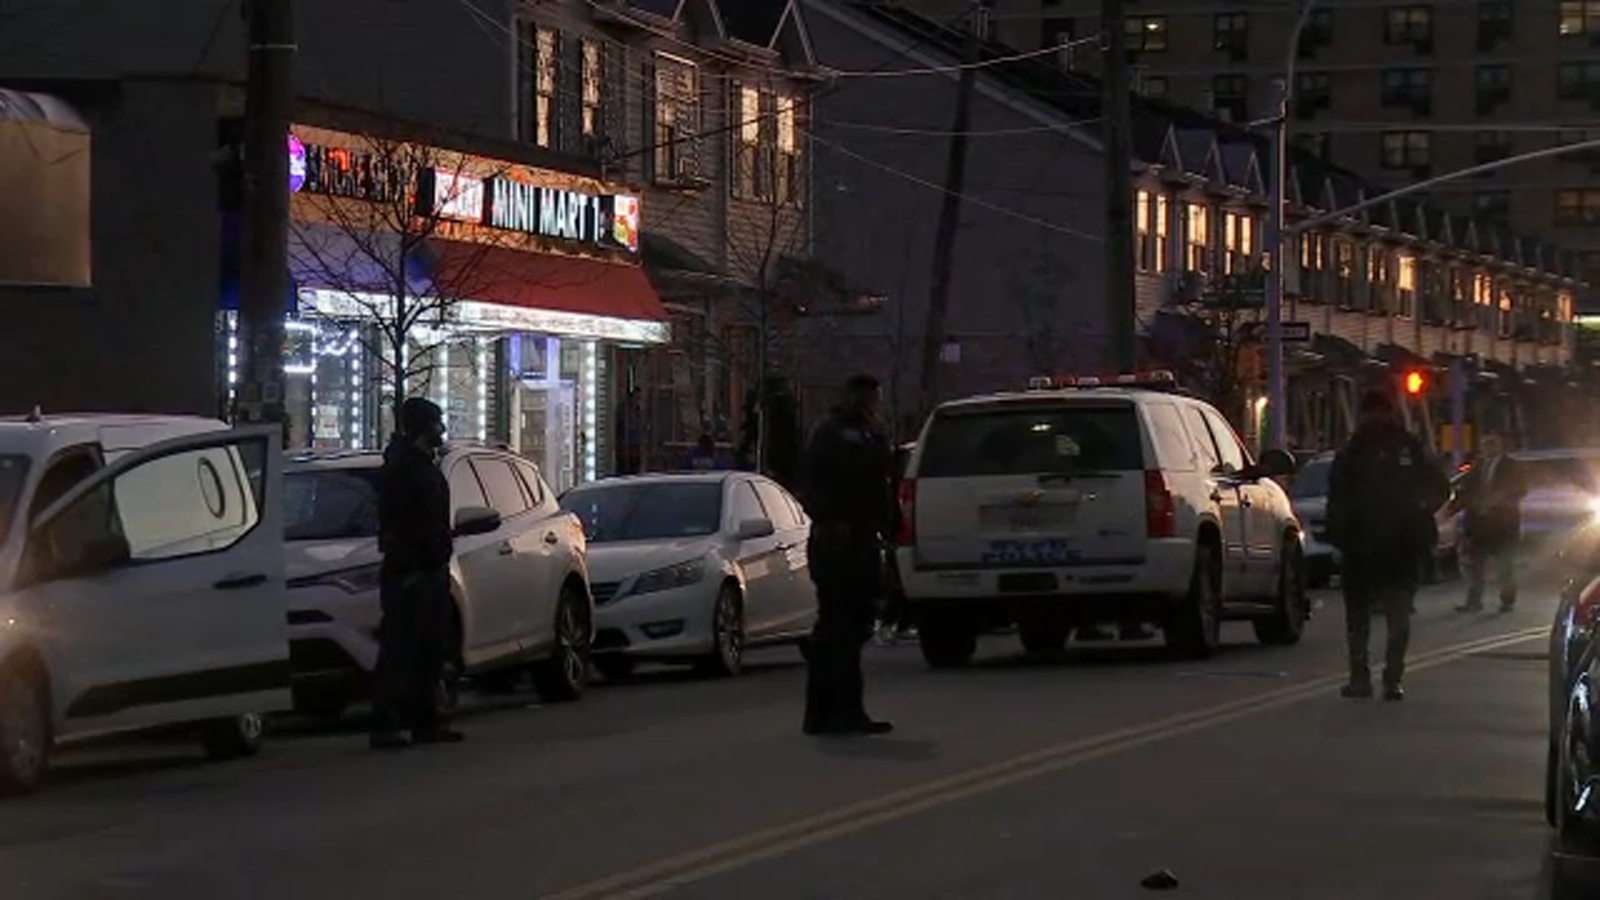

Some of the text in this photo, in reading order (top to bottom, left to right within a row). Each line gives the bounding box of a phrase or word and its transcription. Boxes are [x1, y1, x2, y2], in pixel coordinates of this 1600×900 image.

[492, 178, 535, 232] MINI
[539, 188, 588, 241] MART
[980, 549, 1082, 564] POLICE
